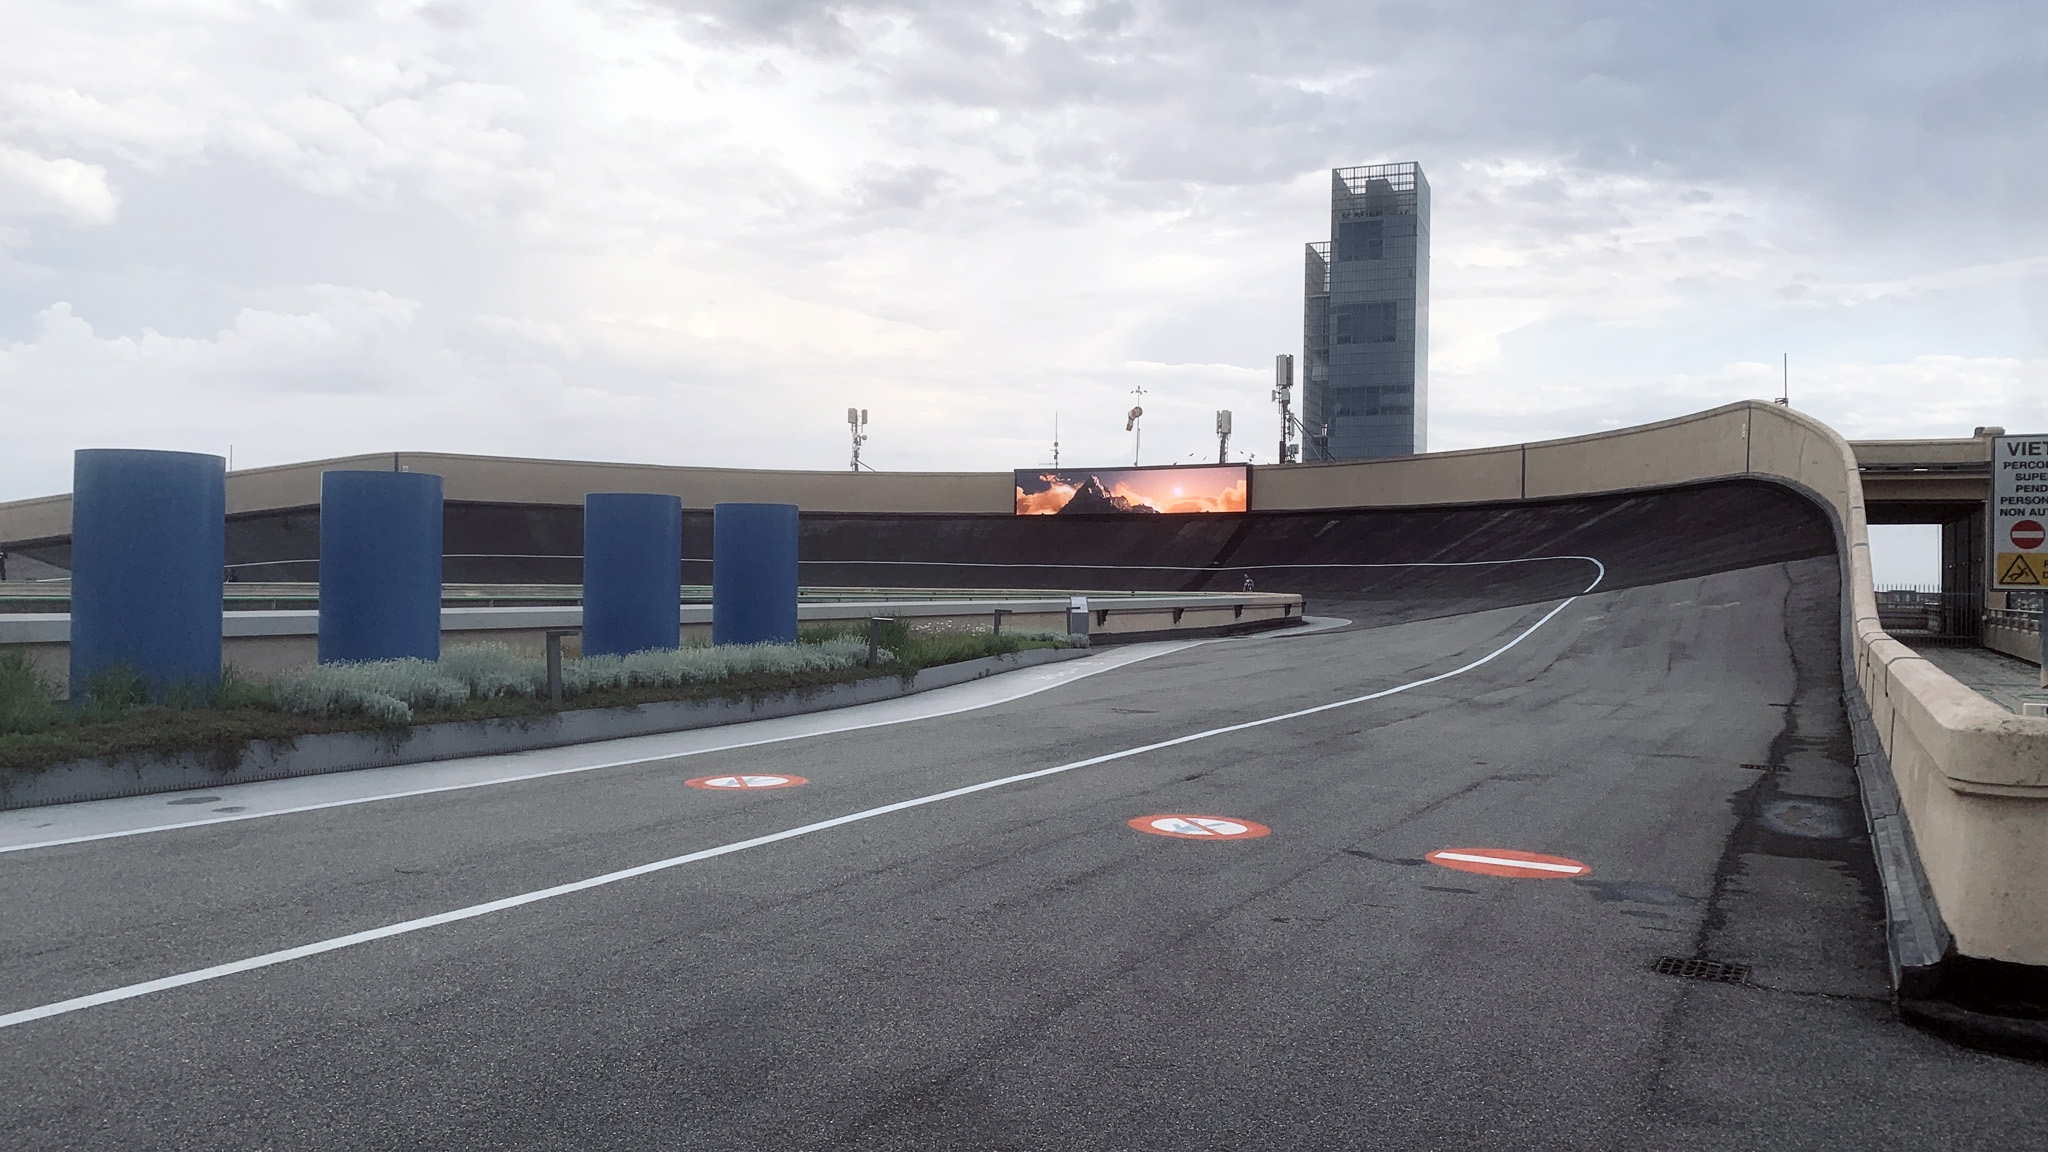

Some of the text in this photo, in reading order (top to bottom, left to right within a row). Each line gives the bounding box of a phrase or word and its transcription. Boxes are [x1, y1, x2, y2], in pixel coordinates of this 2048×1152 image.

[2003, 461, 2048, 469] PERCO
[2000, 508, 2048, 516] NON AU
